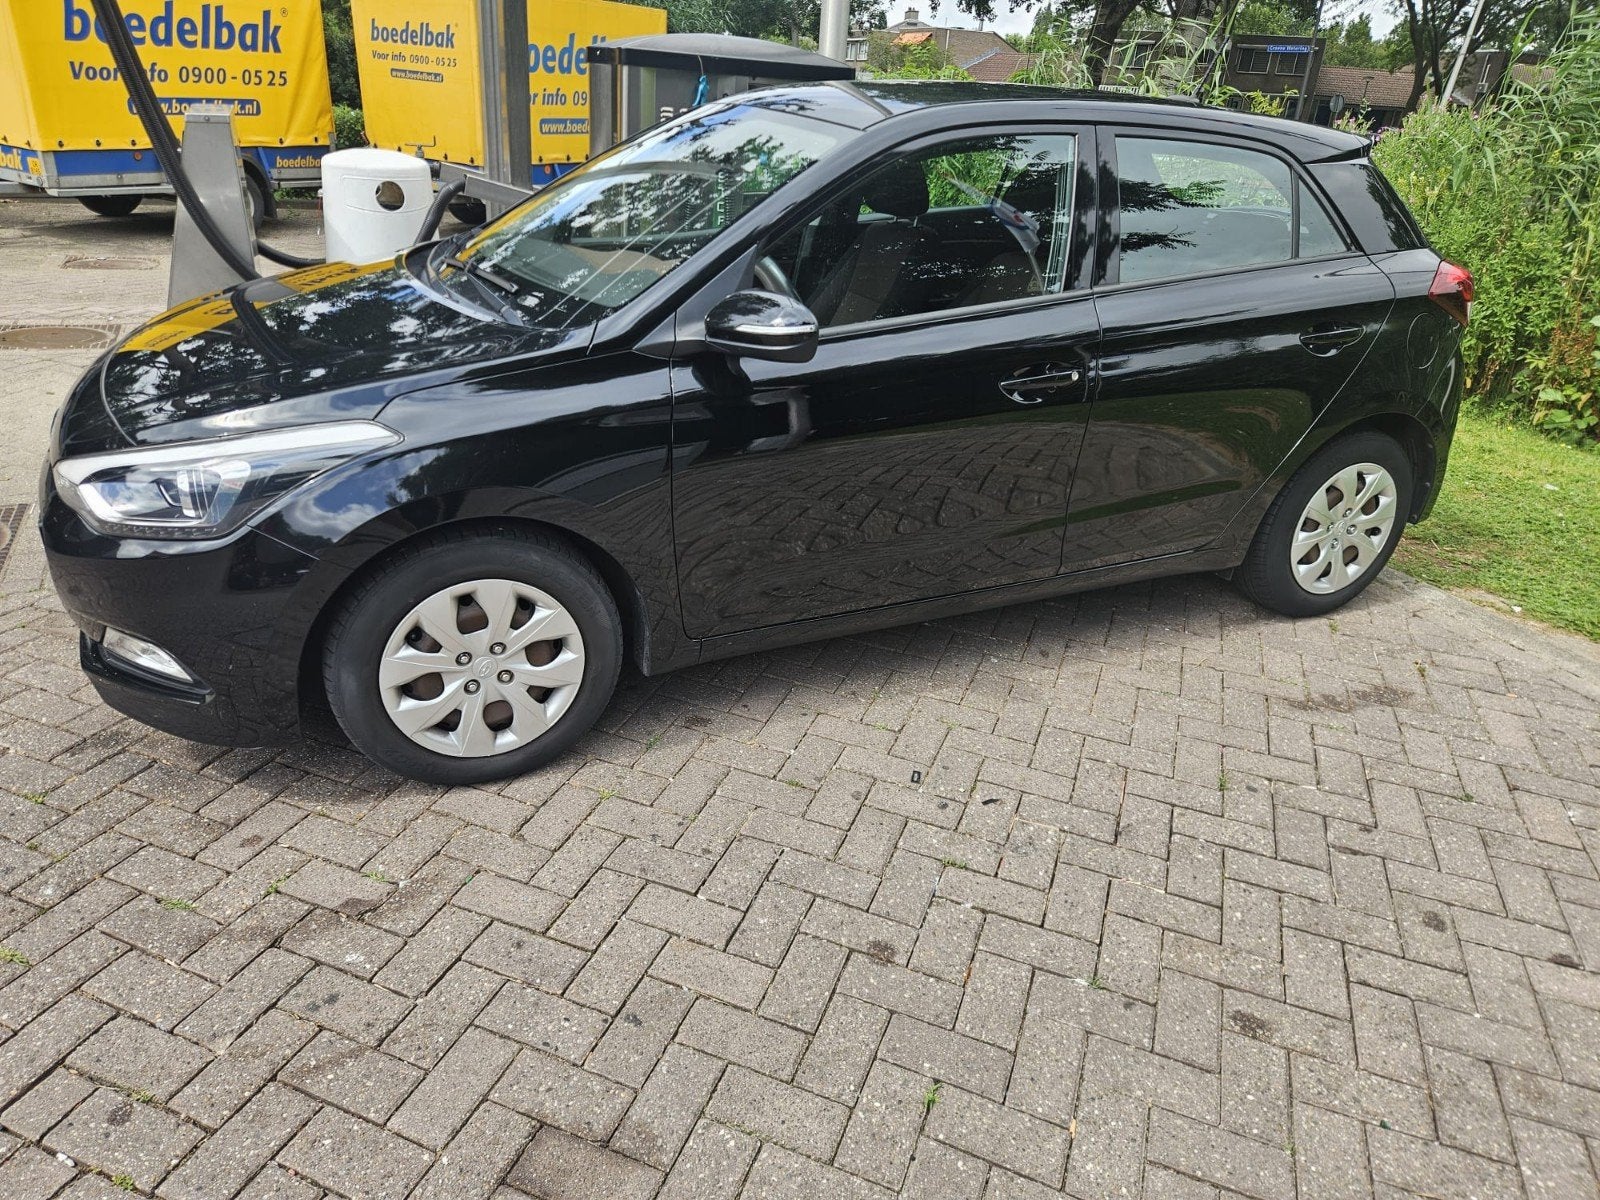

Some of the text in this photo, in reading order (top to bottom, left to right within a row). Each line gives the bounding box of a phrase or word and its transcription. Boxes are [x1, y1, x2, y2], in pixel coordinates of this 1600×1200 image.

[64, 0, 282, 53] bedelbak
[371, 18, 455, 49] boedelbak
[372, 50, 389, 60] Voor
[391, 51, 406, 62] info
[69, 61, 119, 81] Voor
[542, 88, 567, 106] info
[276, 155, 321, 168] boedelba
